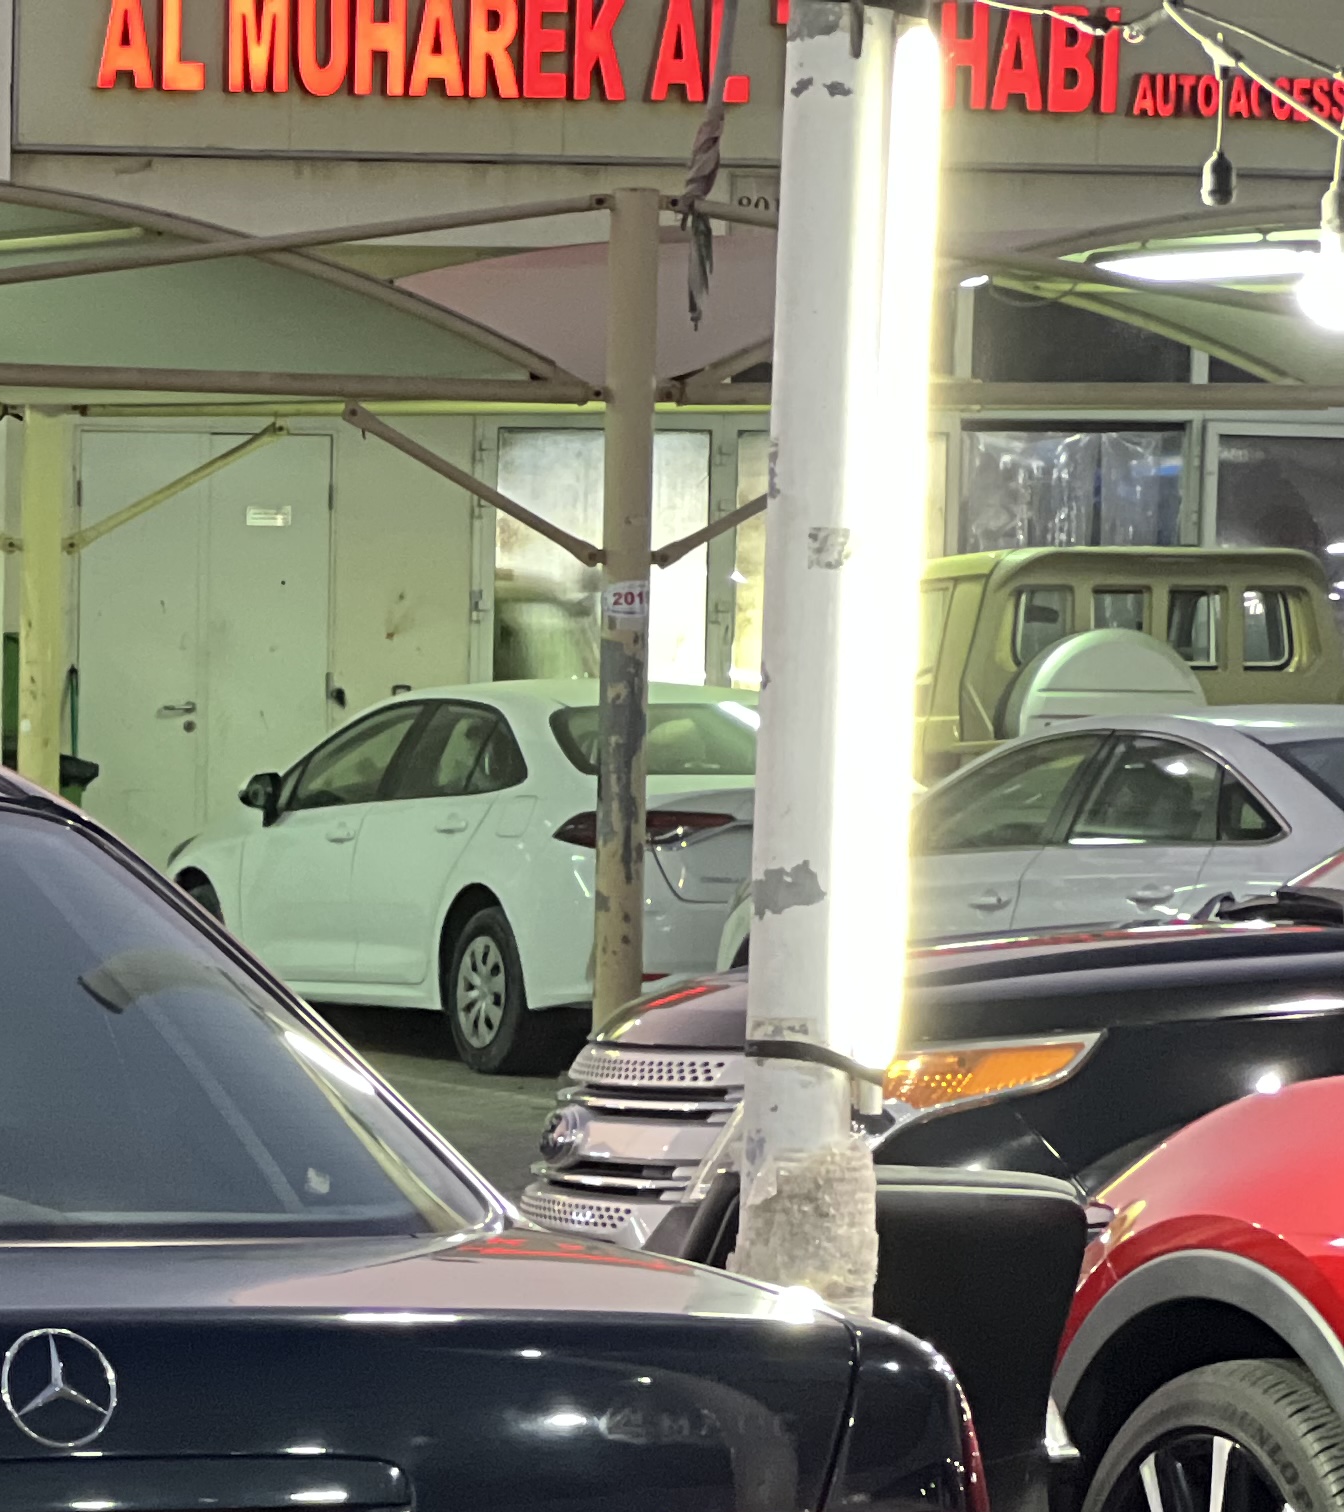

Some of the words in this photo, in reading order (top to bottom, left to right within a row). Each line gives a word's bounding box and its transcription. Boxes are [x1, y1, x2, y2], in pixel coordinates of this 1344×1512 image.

[97, 0, 205, 91] AL
[228, 0, 626, 100] MUHAREK
[1132, 73, 1220, 118] AUTO
